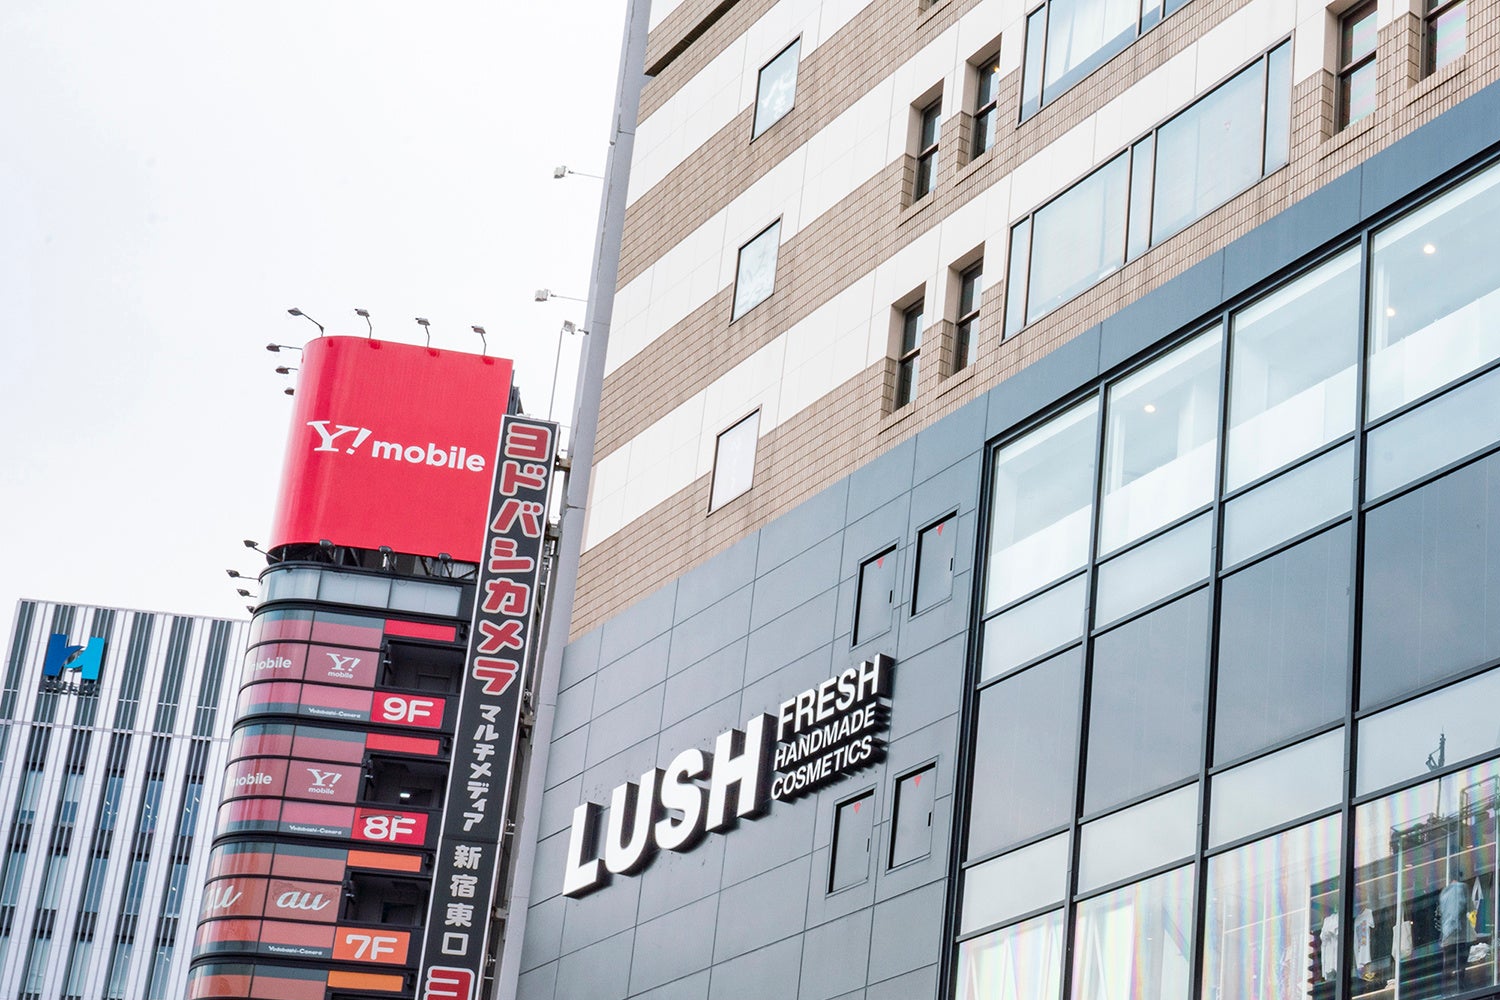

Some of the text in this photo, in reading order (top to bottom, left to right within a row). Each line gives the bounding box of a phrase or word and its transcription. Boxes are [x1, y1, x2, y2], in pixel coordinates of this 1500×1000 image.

[371, 438, 486, 472] mobile
[472, 421, 552, 696] ヨドバシカメラ
[382, 697, 434, 723] 9F
[777, 653, 882, 741] FRESH
[462, 704, 501, 832] マルチメディア
[771, 735, 873, 801] COSMETICS
[773, 702, 878, 771] HANDMADE
[363, 815, 416, 841] 8F
[563, 712, 766, 897] LUSH
[276, 890, 331, 911] au
[441, 844, 483, 957] 新宿東口
[346, 934, 398, 961] 7F
